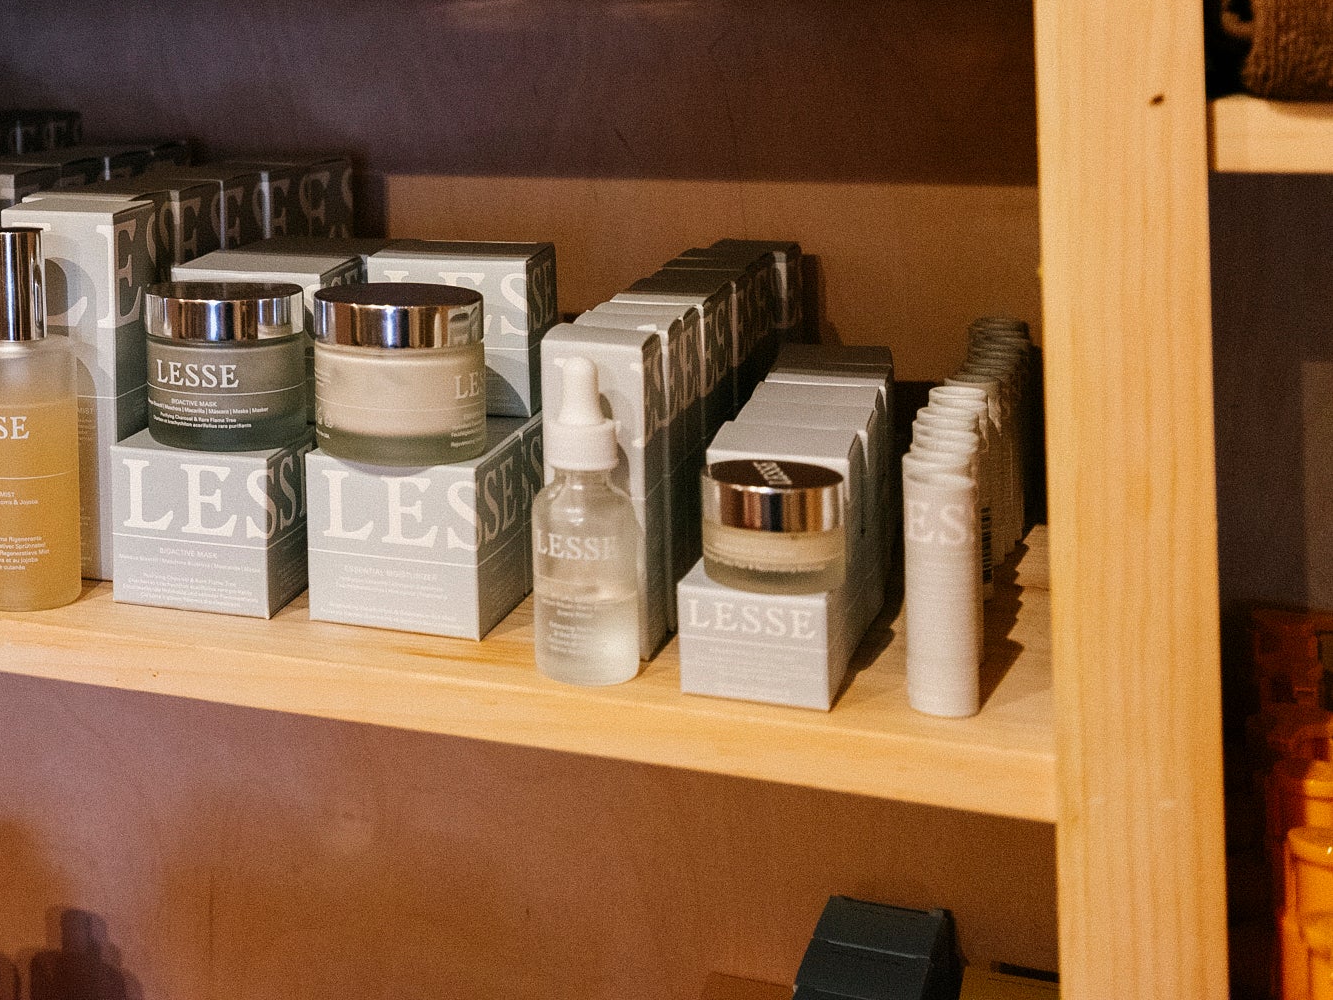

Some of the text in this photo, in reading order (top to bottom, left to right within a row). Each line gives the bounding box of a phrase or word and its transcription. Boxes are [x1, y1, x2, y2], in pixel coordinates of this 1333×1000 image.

[157, 359, 239, 388] LESSE
[322, 456, 516, 551] LESSE
[688, 598, 816, 639] LESSE
